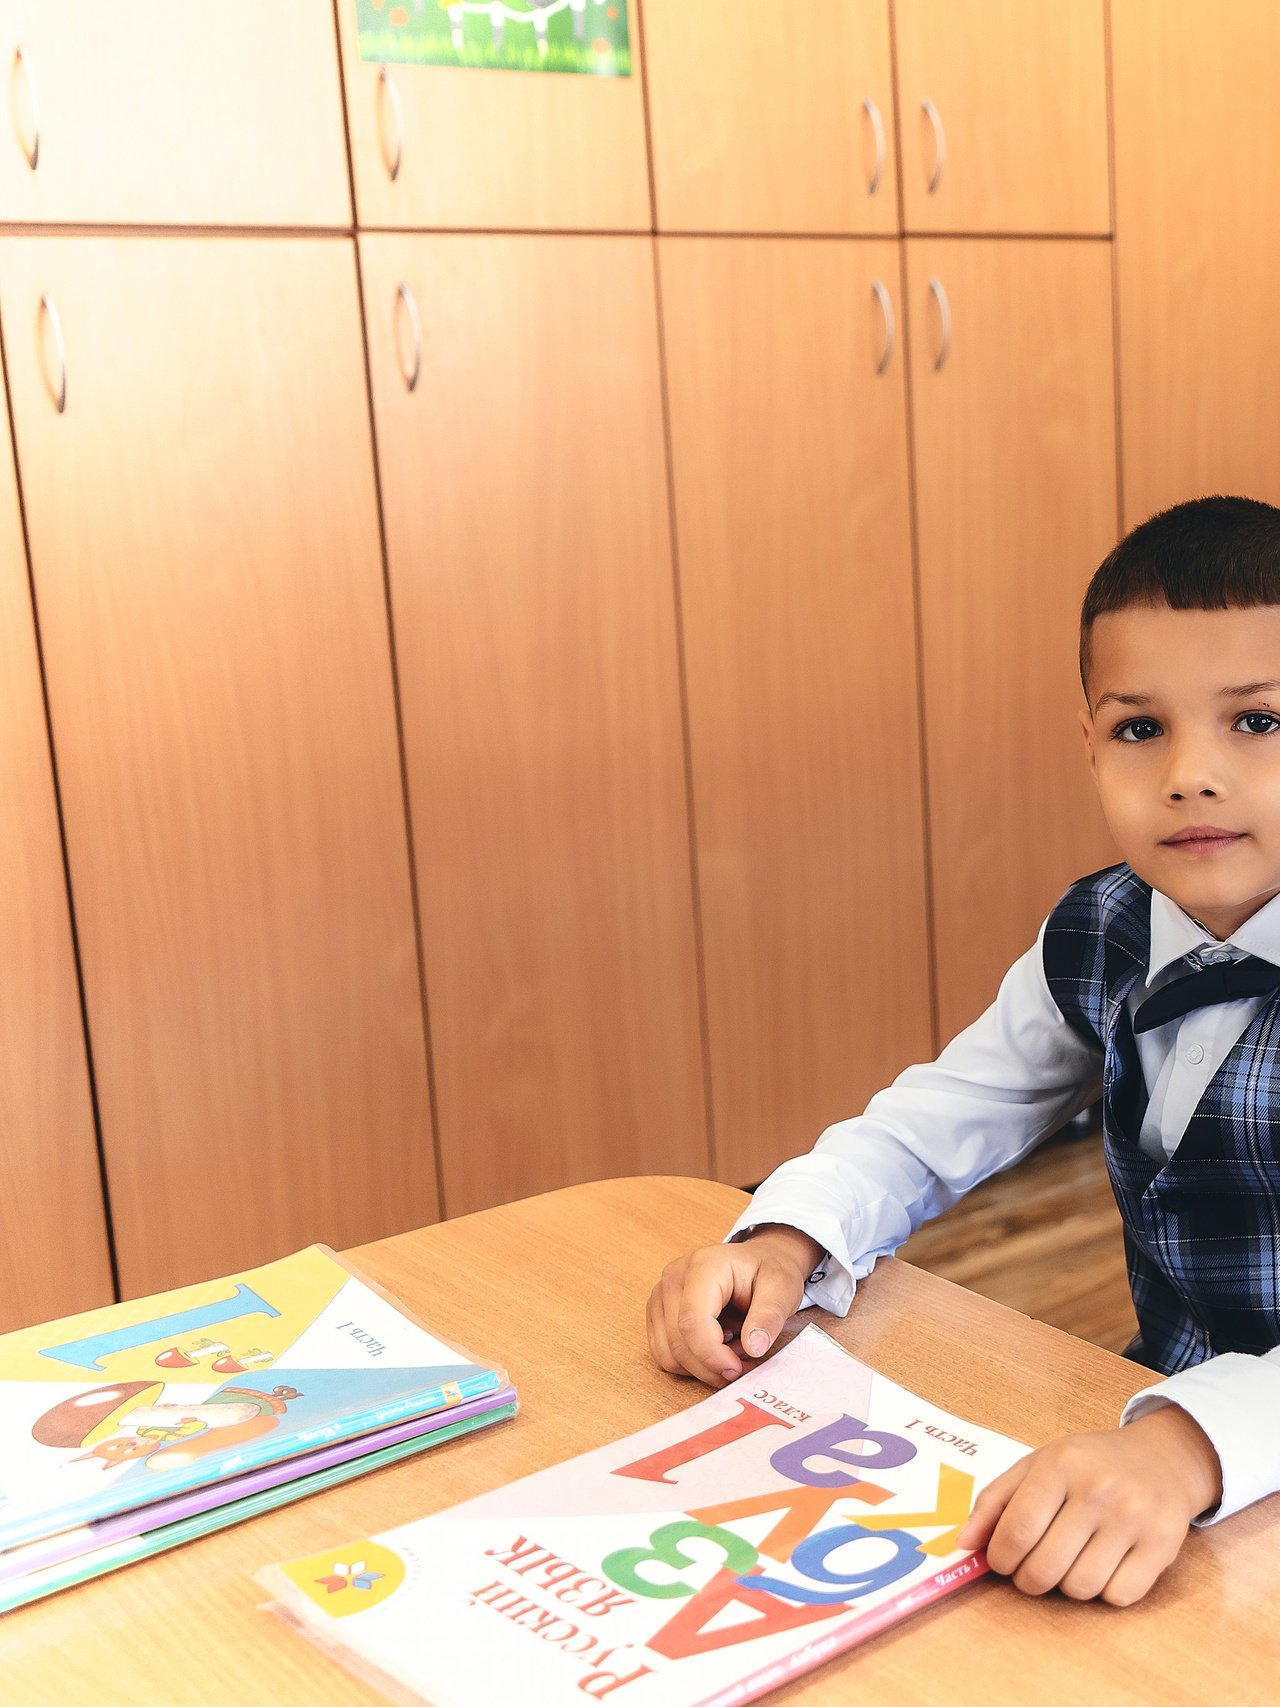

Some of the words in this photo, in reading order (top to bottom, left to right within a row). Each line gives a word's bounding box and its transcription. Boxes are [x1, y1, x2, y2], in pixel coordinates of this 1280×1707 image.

[38, 1283, 282, 1371] 1
[336, 1321, 355, 1330] 1
[349, 1328, 388, 1357] Часть
[753, 1389, 812, 1423] класс
[904, 1418, 923, 1430] 1
[609, 1397, 796, 1485] 1
[925, 1425, 978, 1457] Часть
[934, 1563, 971, 1586] Часть
[971, 1556, 980, 1569] 1
[462, 1579, 659, 1701] Русский
